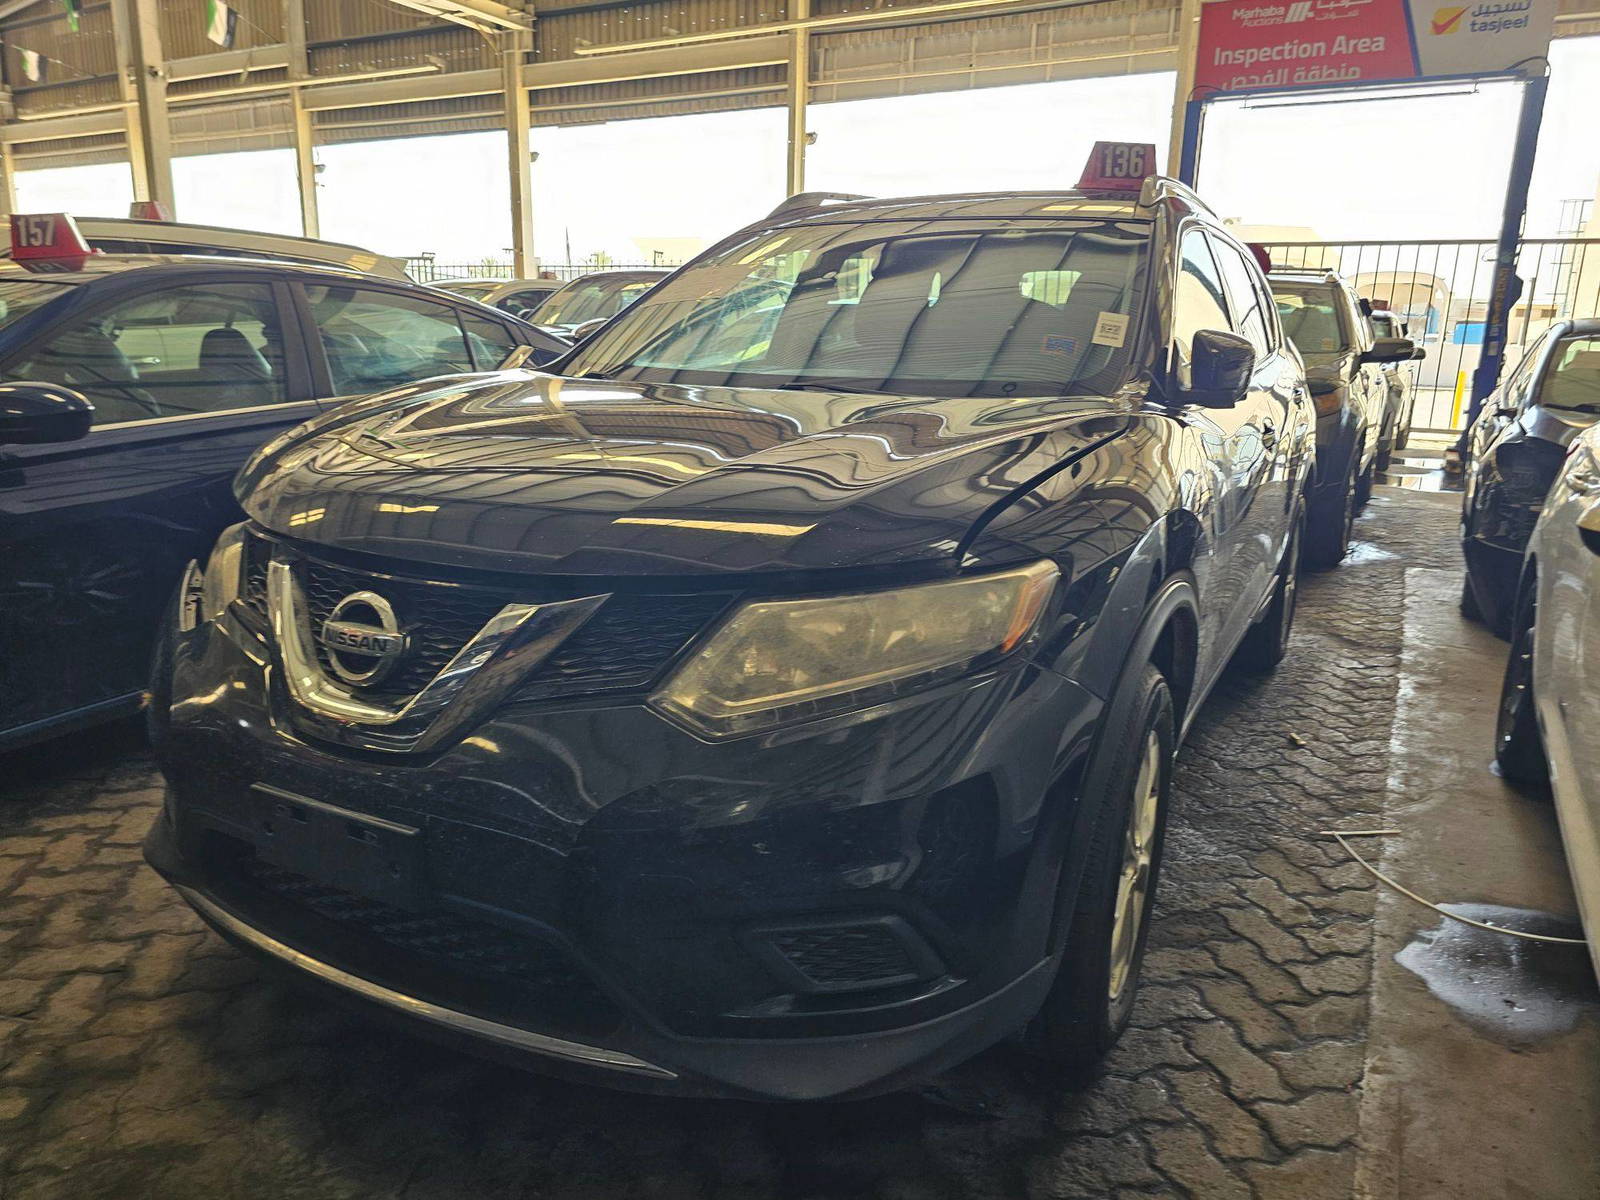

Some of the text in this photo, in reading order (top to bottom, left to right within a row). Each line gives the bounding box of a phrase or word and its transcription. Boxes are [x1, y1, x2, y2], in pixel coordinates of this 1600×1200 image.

[1232, 5, 1285, 20] Marhaba
[1470, 15, 1529, 33] tasjeel
[1213, 35, 1386, 68] Inspection Area
[1293, 62, 1361, 83] منطقة
[1103, 145, 1145, 178] 136
[17, 216, 55, 247] 157
[325, 629, 387, 651] NISSAN
